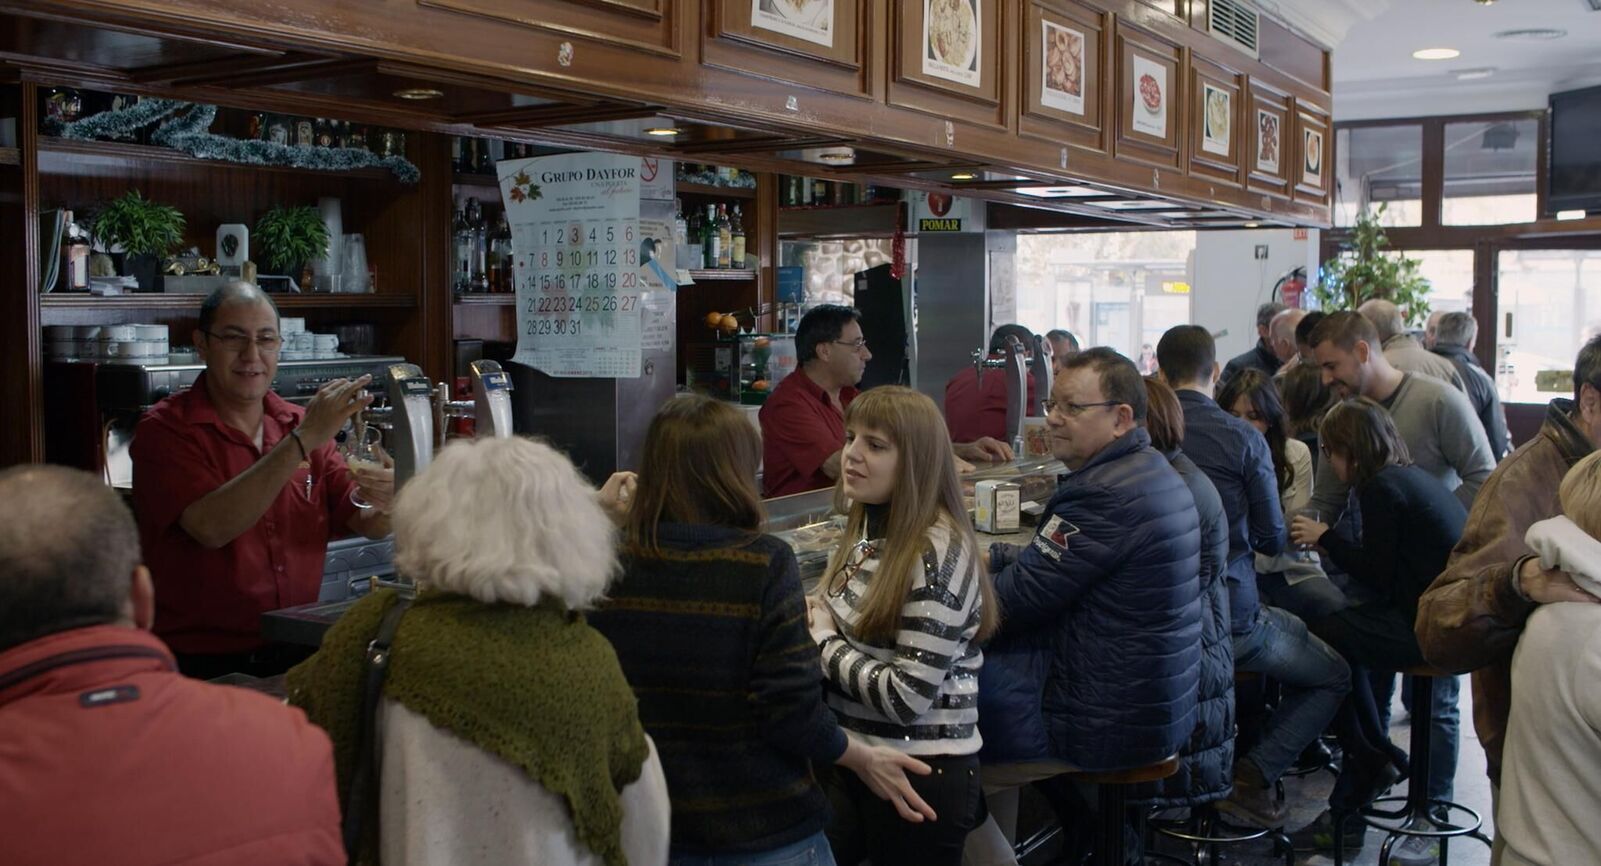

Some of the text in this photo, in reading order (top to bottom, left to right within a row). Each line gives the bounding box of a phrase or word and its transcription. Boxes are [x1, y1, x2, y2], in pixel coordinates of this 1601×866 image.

[542, 168, 635, 184] GRUPO DAYFOR
[922, 219, 959, 231] POMAR
[543, 230, 548, 244] 1
[556, 229, 564, 244] 2
[571, 228, 580, 243] 3
[589, 228, 596, 242] 4
[606, 227, 614, 242] 5
[625, 226, 634, 242] 6
[529, 249, 636, 267] 7 8 9 10 11 12 13
[527, 272, 637, 290] 14 15 16 17 18 19 20
[527, 296, 638, 313] 21 22 23 24 25 26 27
[527, 320, 581, 335] 28 29 30 31
